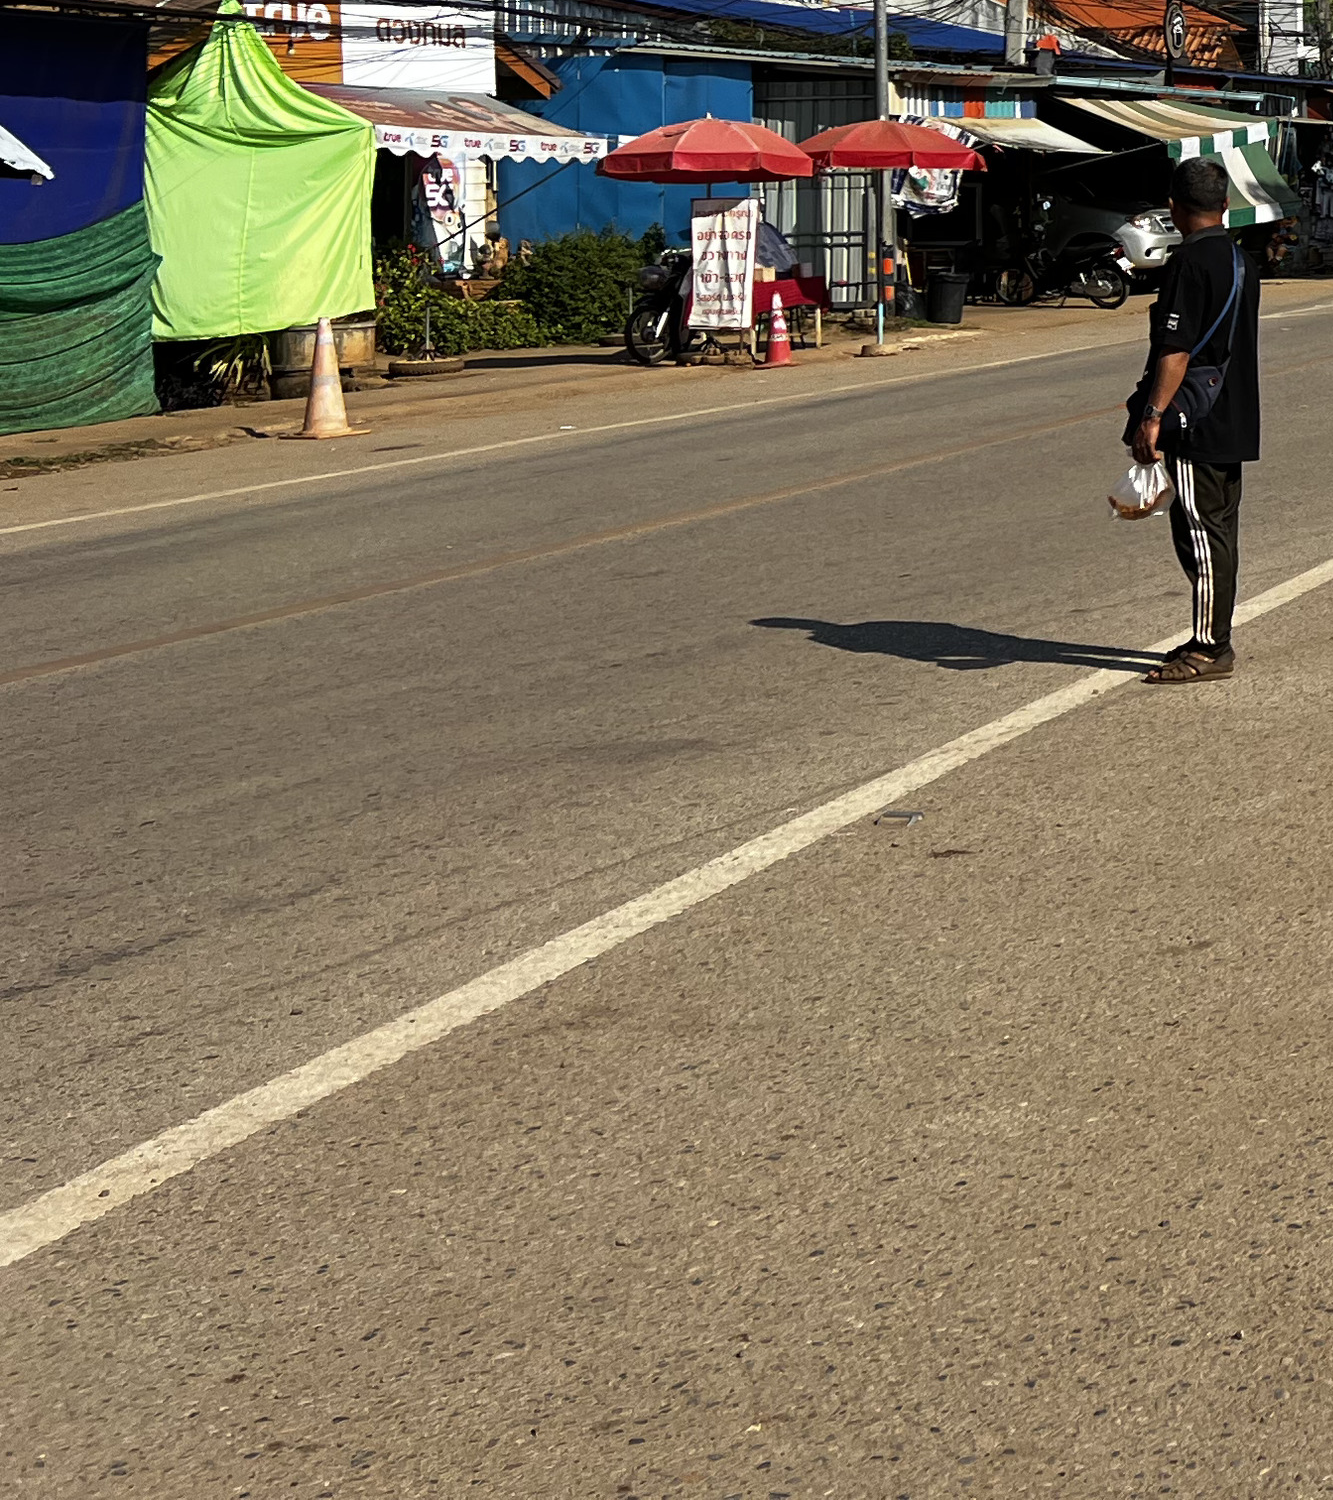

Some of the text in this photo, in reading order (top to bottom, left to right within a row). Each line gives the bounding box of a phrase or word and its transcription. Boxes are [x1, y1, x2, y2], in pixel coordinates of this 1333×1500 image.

[383, 132, 402, 143] true
[431, 135, 449, 149] 5G
[464, 138, 482, 149] true
[509, 139, 526, 152] 5G
[541, 141, 558, 152] true
[583, 142, 600, 155] 5G
